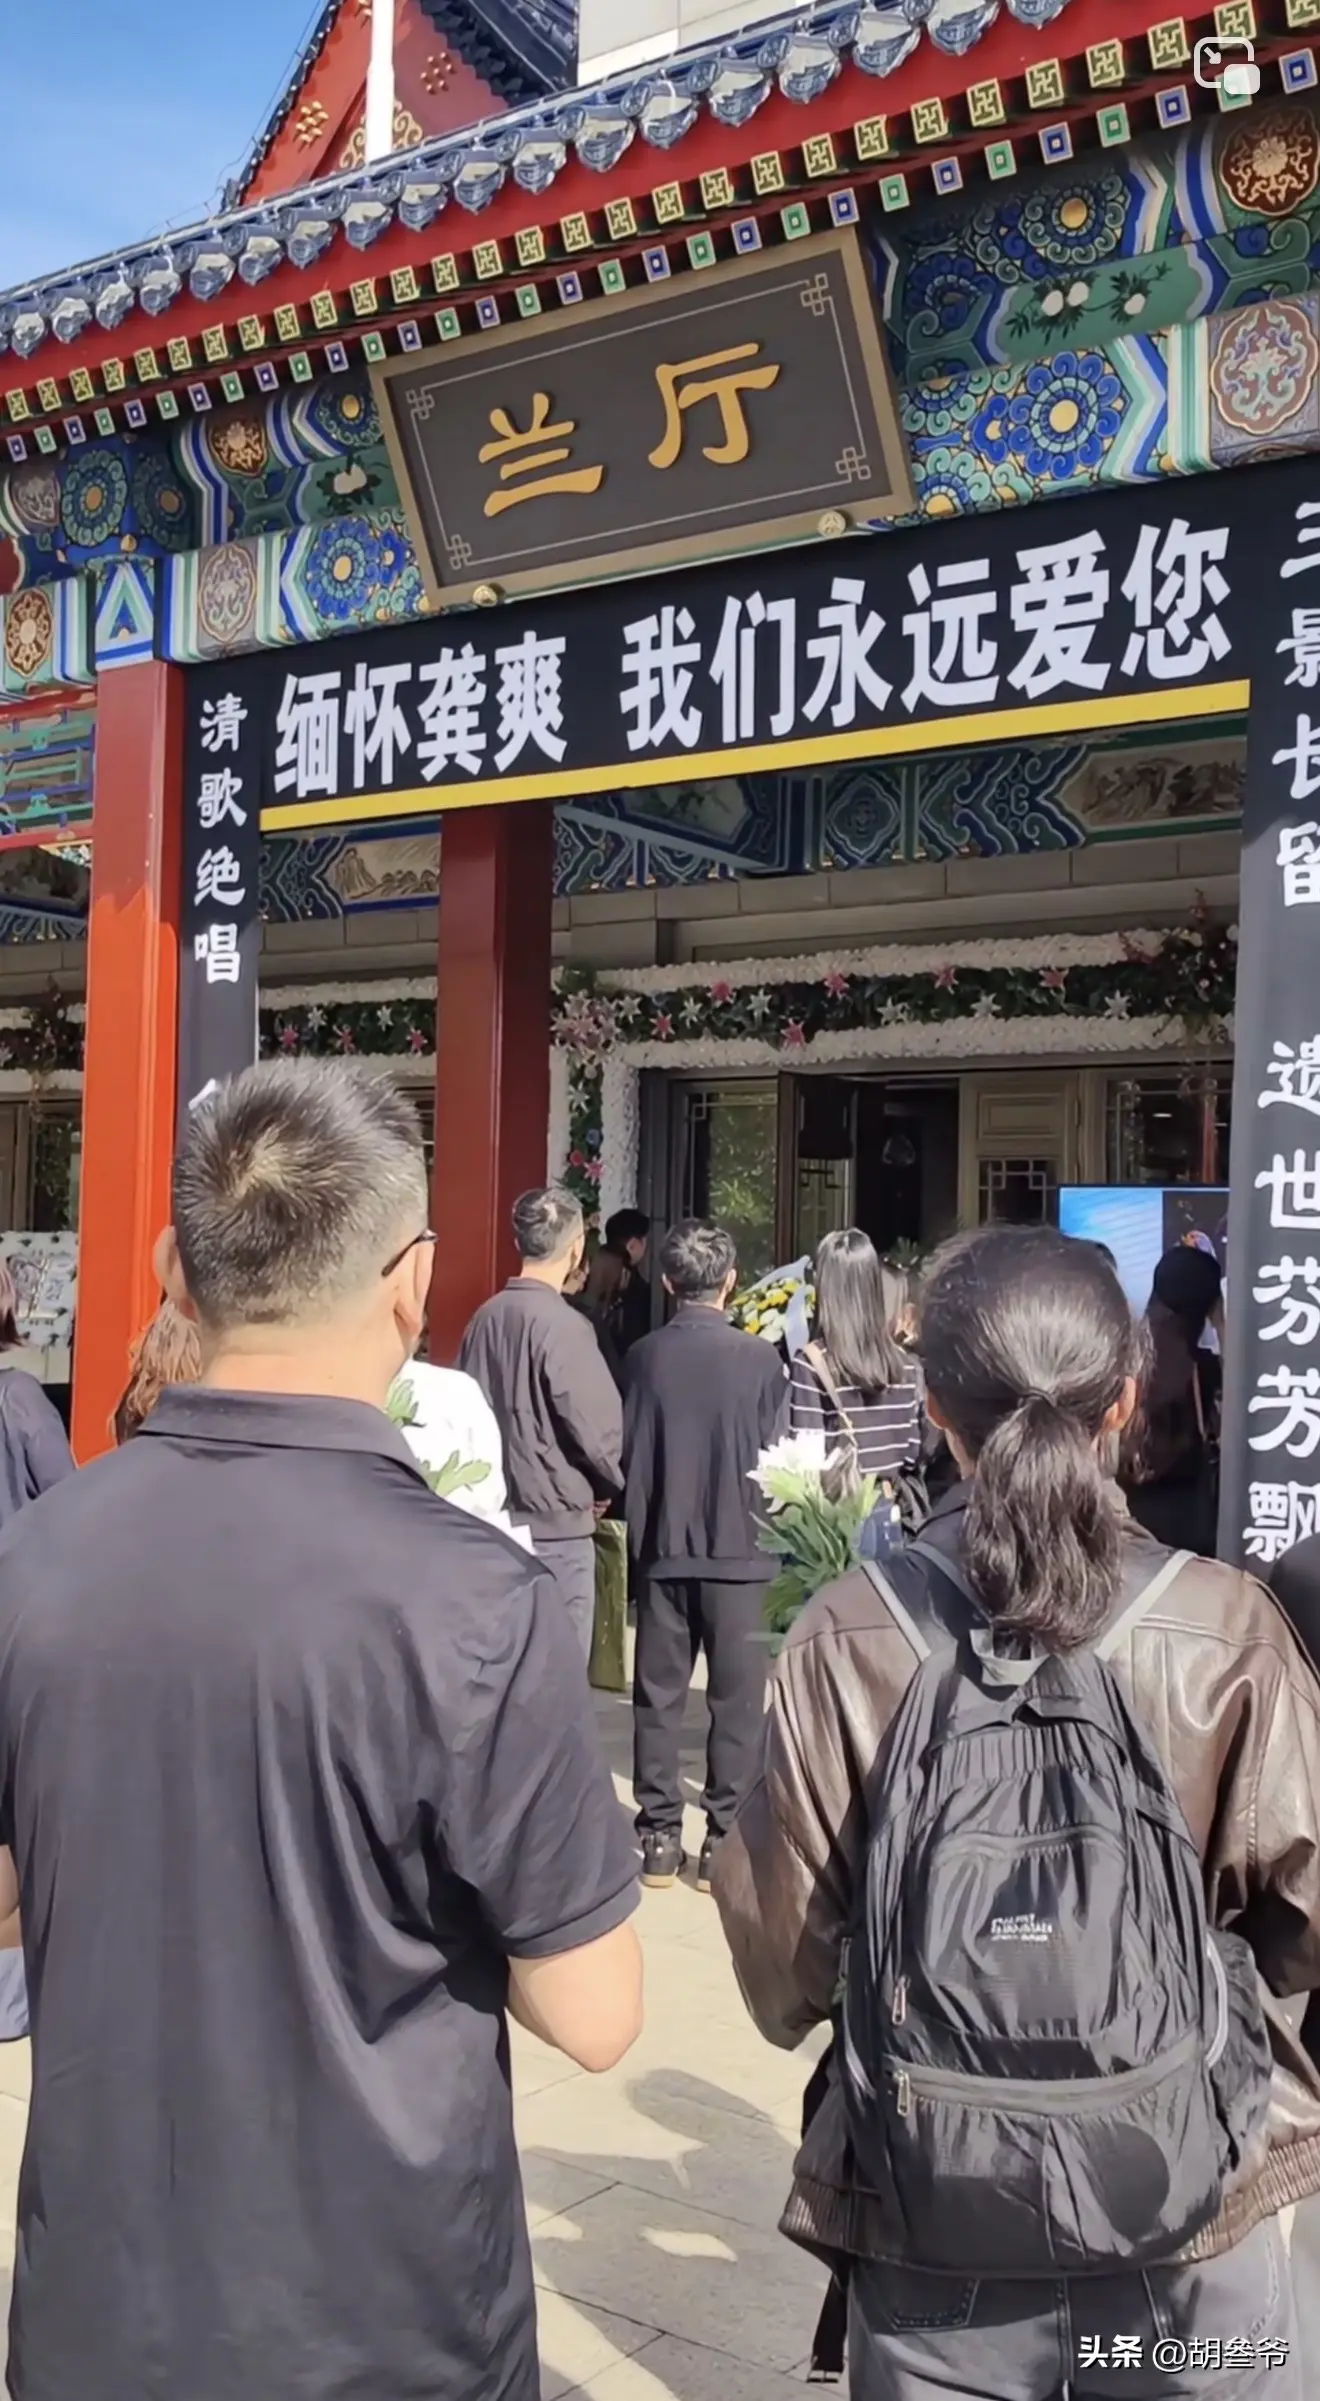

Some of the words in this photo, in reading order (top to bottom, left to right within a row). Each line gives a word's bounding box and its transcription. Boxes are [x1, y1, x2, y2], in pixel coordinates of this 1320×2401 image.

[478, 342, 780, 517] 兰厅
[274, 630, 568, 798] 缅怀龚爽
[620, 517, 1231, 752] 我们永远爱您
[194, 692, 248, 984] 清歌绝唱
